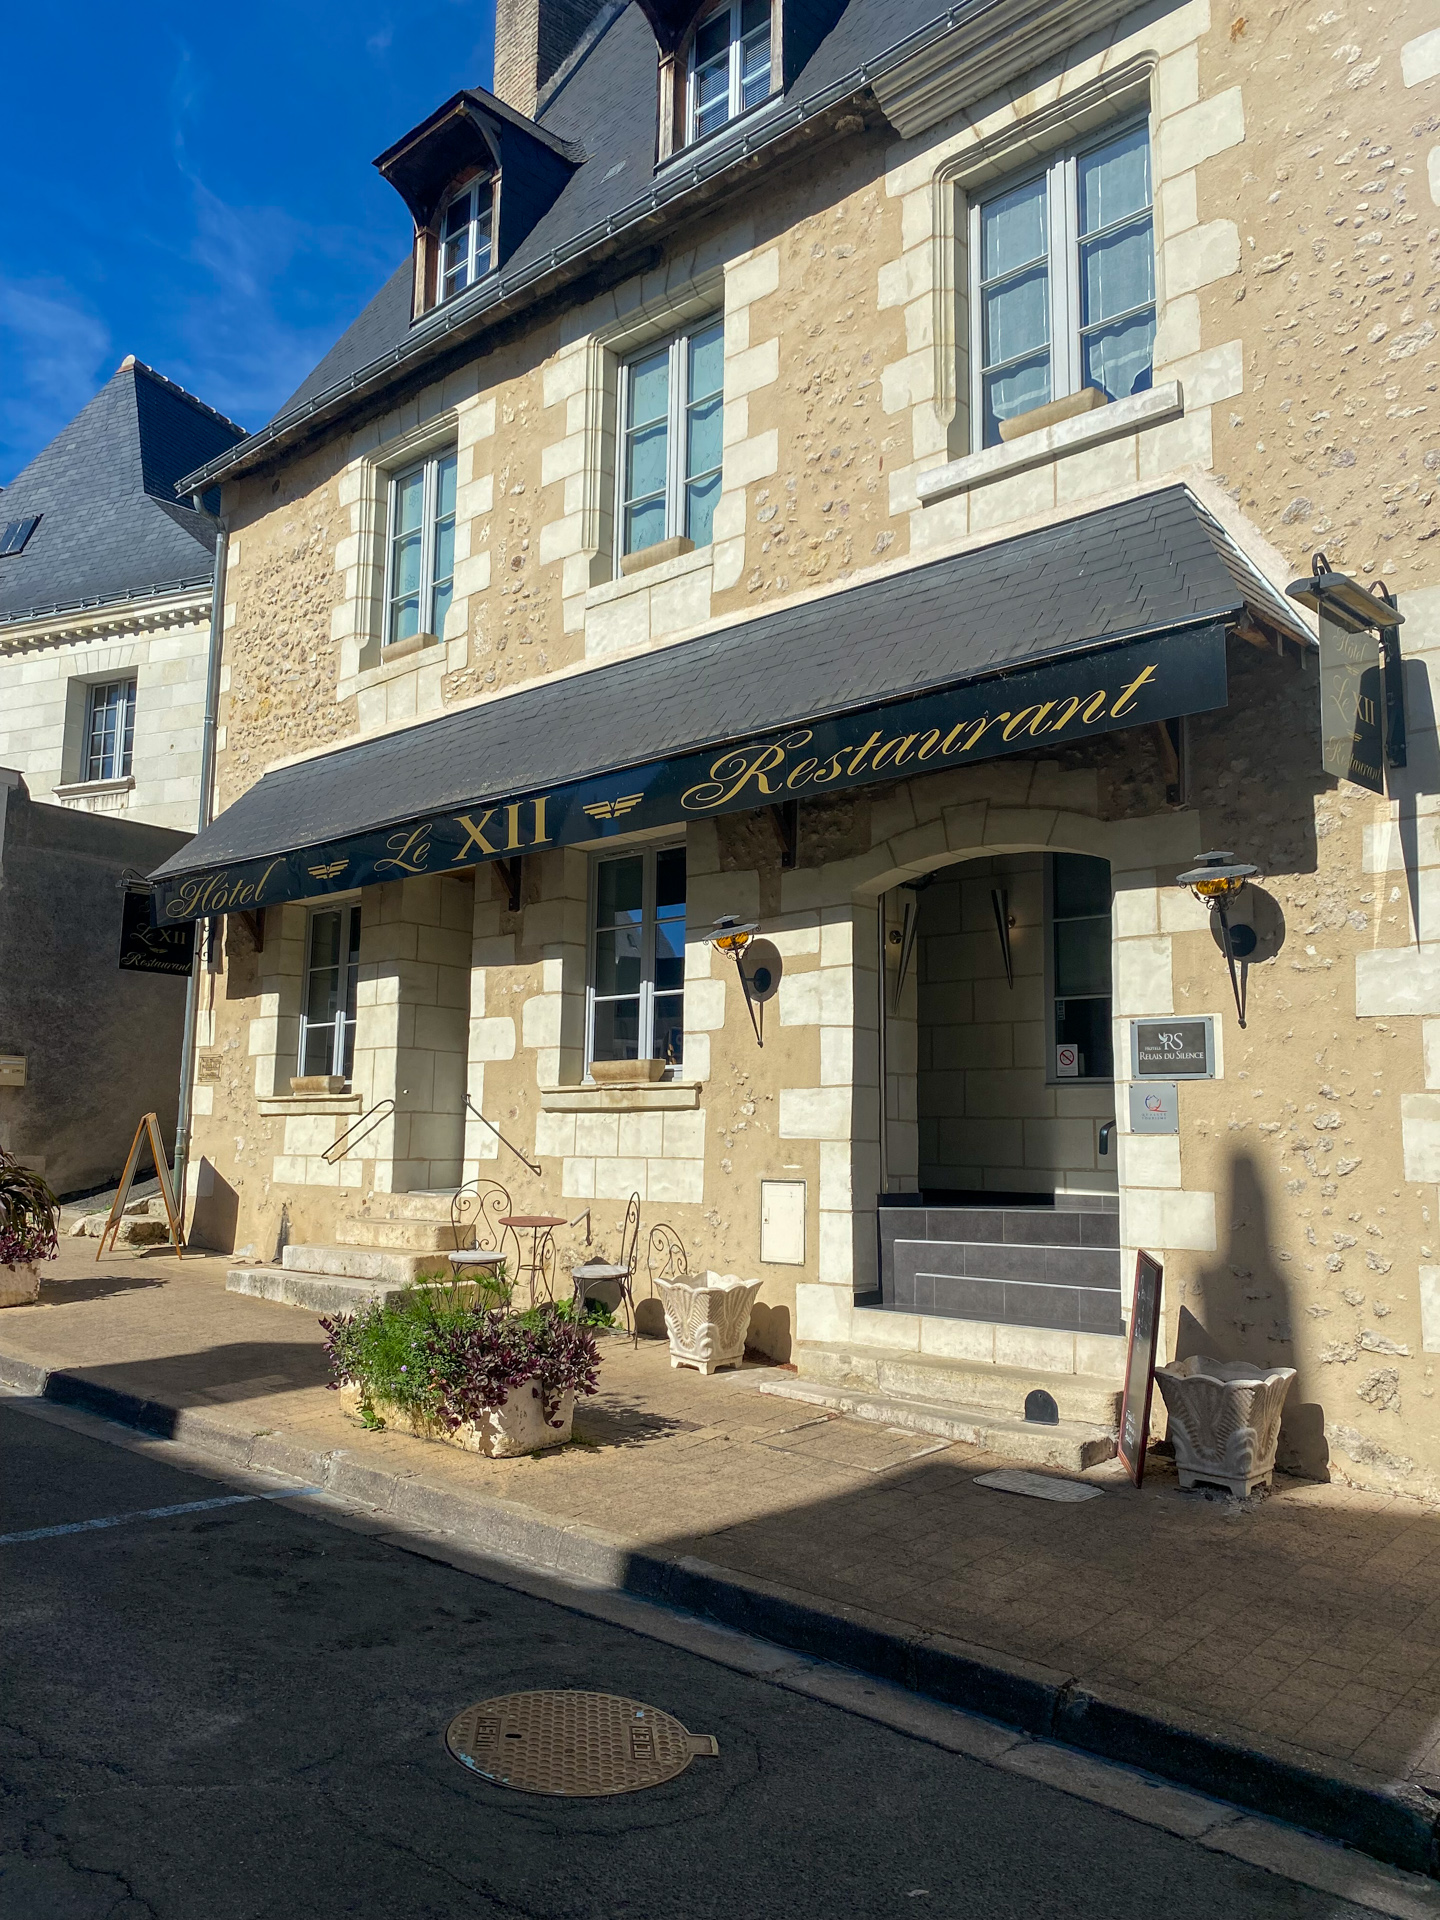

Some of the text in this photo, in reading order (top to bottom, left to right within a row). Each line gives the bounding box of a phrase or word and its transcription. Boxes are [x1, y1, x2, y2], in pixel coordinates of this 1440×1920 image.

[1329, 675, 1376, 726] Le XII
[165, 662, 1159, 919] Hôtel Le XII Restaurant
[130, 923, 186, 946] Le XII
[121, 952, 192, 972] Restaurant
[631, 1728, 652, 1759] ACIER
